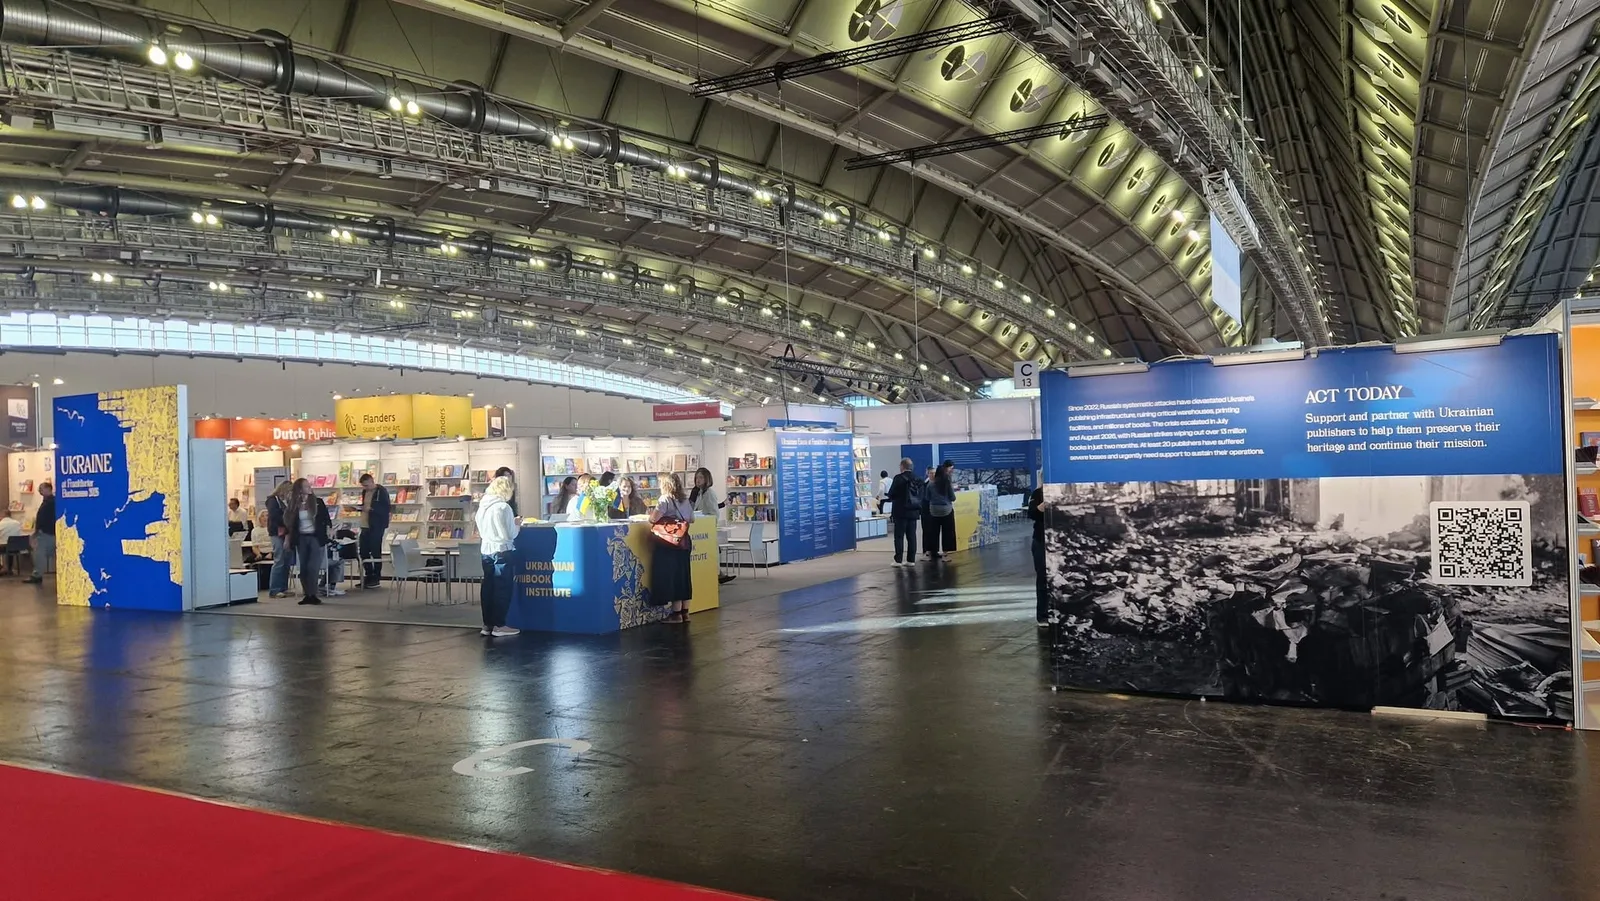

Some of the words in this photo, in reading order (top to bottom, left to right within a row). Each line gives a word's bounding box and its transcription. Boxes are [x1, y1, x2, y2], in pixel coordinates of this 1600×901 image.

[1021, 364, 1032, 376] C
[1022, 378, 1032, 386] 13
[1305, 388, 1340, 404] ACT
[1344, 386, 1402, 402] TODAY
[1122, 401, 1153, 410] systematic
[1192, 396, 1226, 404] devastated
[363, 413, 396, 424] Flanders
[1096, 412, 1136, 420] infrastructure,
[1177, 408, 1214, 416] warehouses,
[1305, 412, 1346, 424] Support
[1349, 412, 1368, 421] and
[1371, 410, 1410, 422] partner
[1413, 408, 1435, 419] with
[1439, 406, 1494, 418] Ukrainian
[273, 428, 306, 440] Dutch
[308, 428, 336, 440] Publis
[1307, 427, 1356, 439] publishers
[1360, 427, 1368, 436] to
[1371, 425, 1393, 436] help
[1396, 424, 1422, 434] them
[1426, 424, 1472, 435] preserve
[1475, 422, 1500, 432] their
[1171, 440, 1201, 448] publishers
[1307, 442, 1345, 453] heritage
[1348, 442, 1366, 450] and
[1370, 440, 1412, 450] continue
[1416, 440, 1440, 449] their
[1444, 439, 1487, 448] mission.
[1159, 450, 1183, 458] support
[1229, 448, 1264, 457] operations.
[61, 453, 112, 475] UKRAINE
[526, 561, 575, 572] UKRAINIAN
[526, 574, 551, 584] BOOK
[526, 587, 571, 597] INSTITUTE
